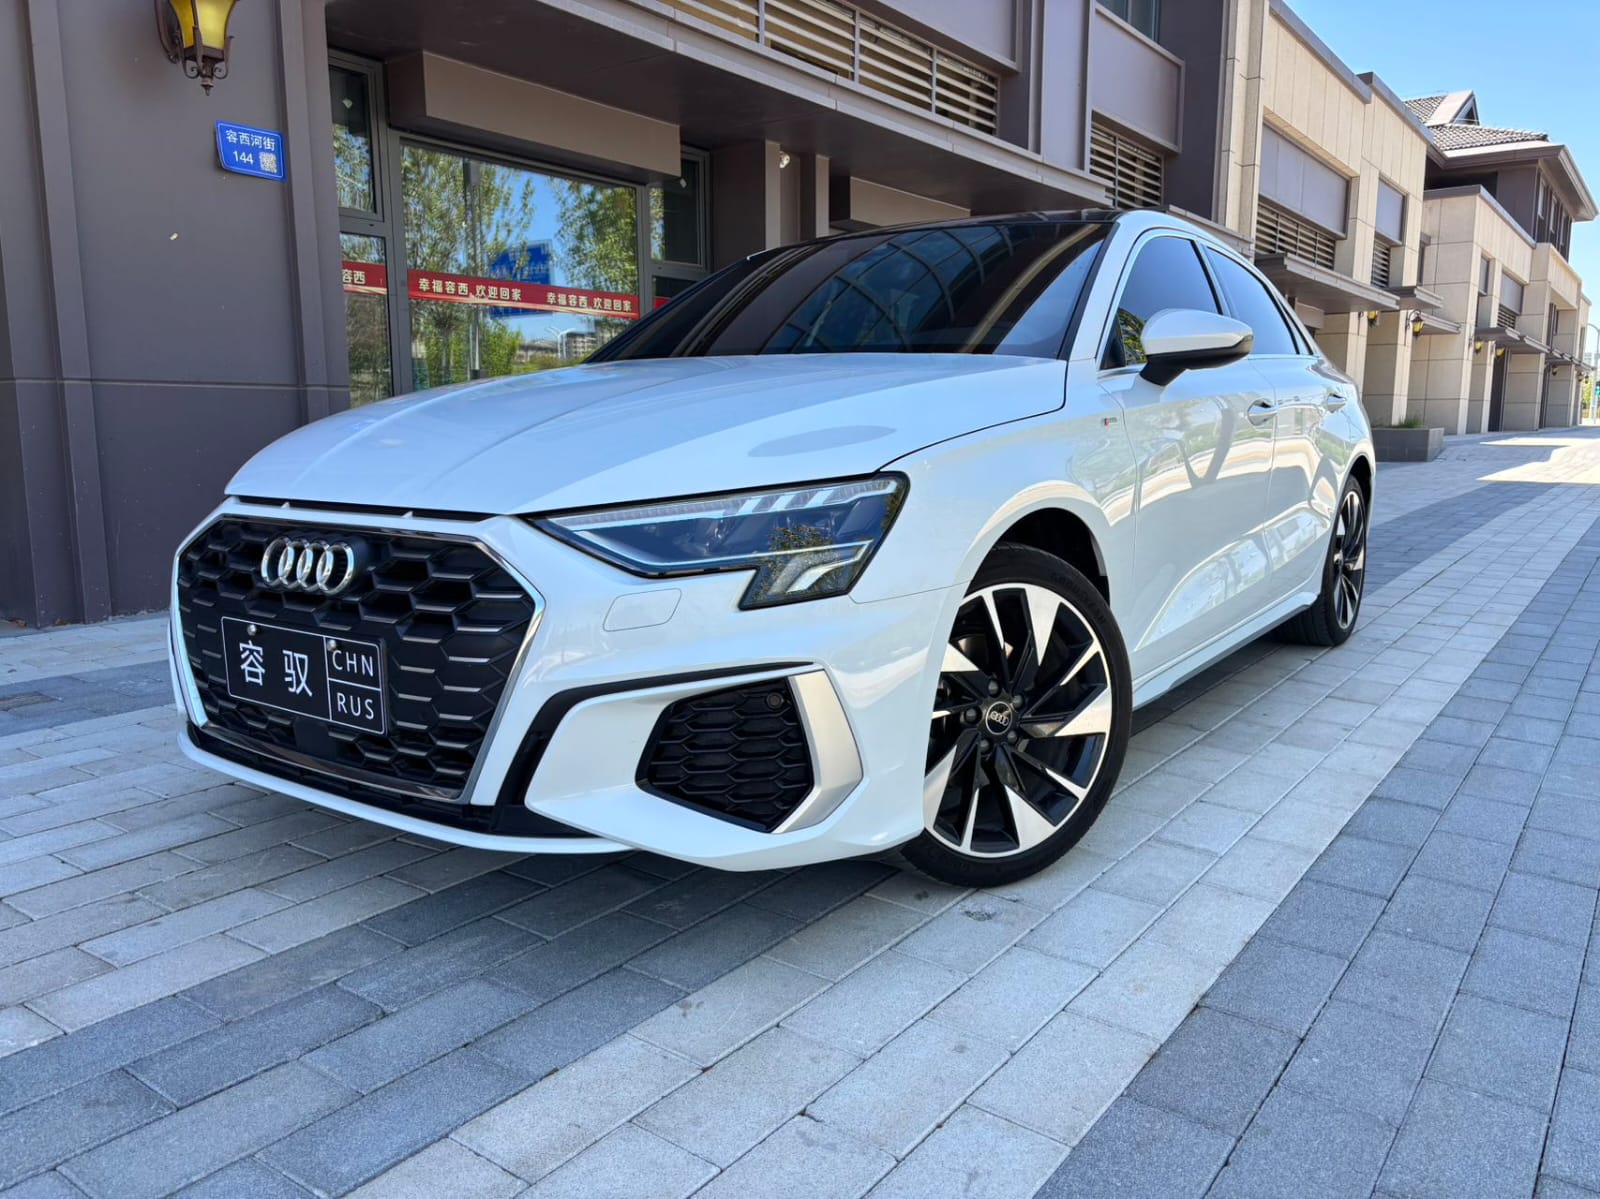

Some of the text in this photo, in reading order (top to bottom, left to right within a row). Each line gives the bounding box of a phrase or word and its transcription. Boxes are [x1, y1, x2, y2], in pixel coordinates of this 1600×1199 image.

[225, 129, 276, 151] 容西河街
[233, 150, 254, 165] 144
[341, 268, 366, 285] 容西
[332, 650, 374, 677] CHN
[336, 692, 375, 720] RUS
